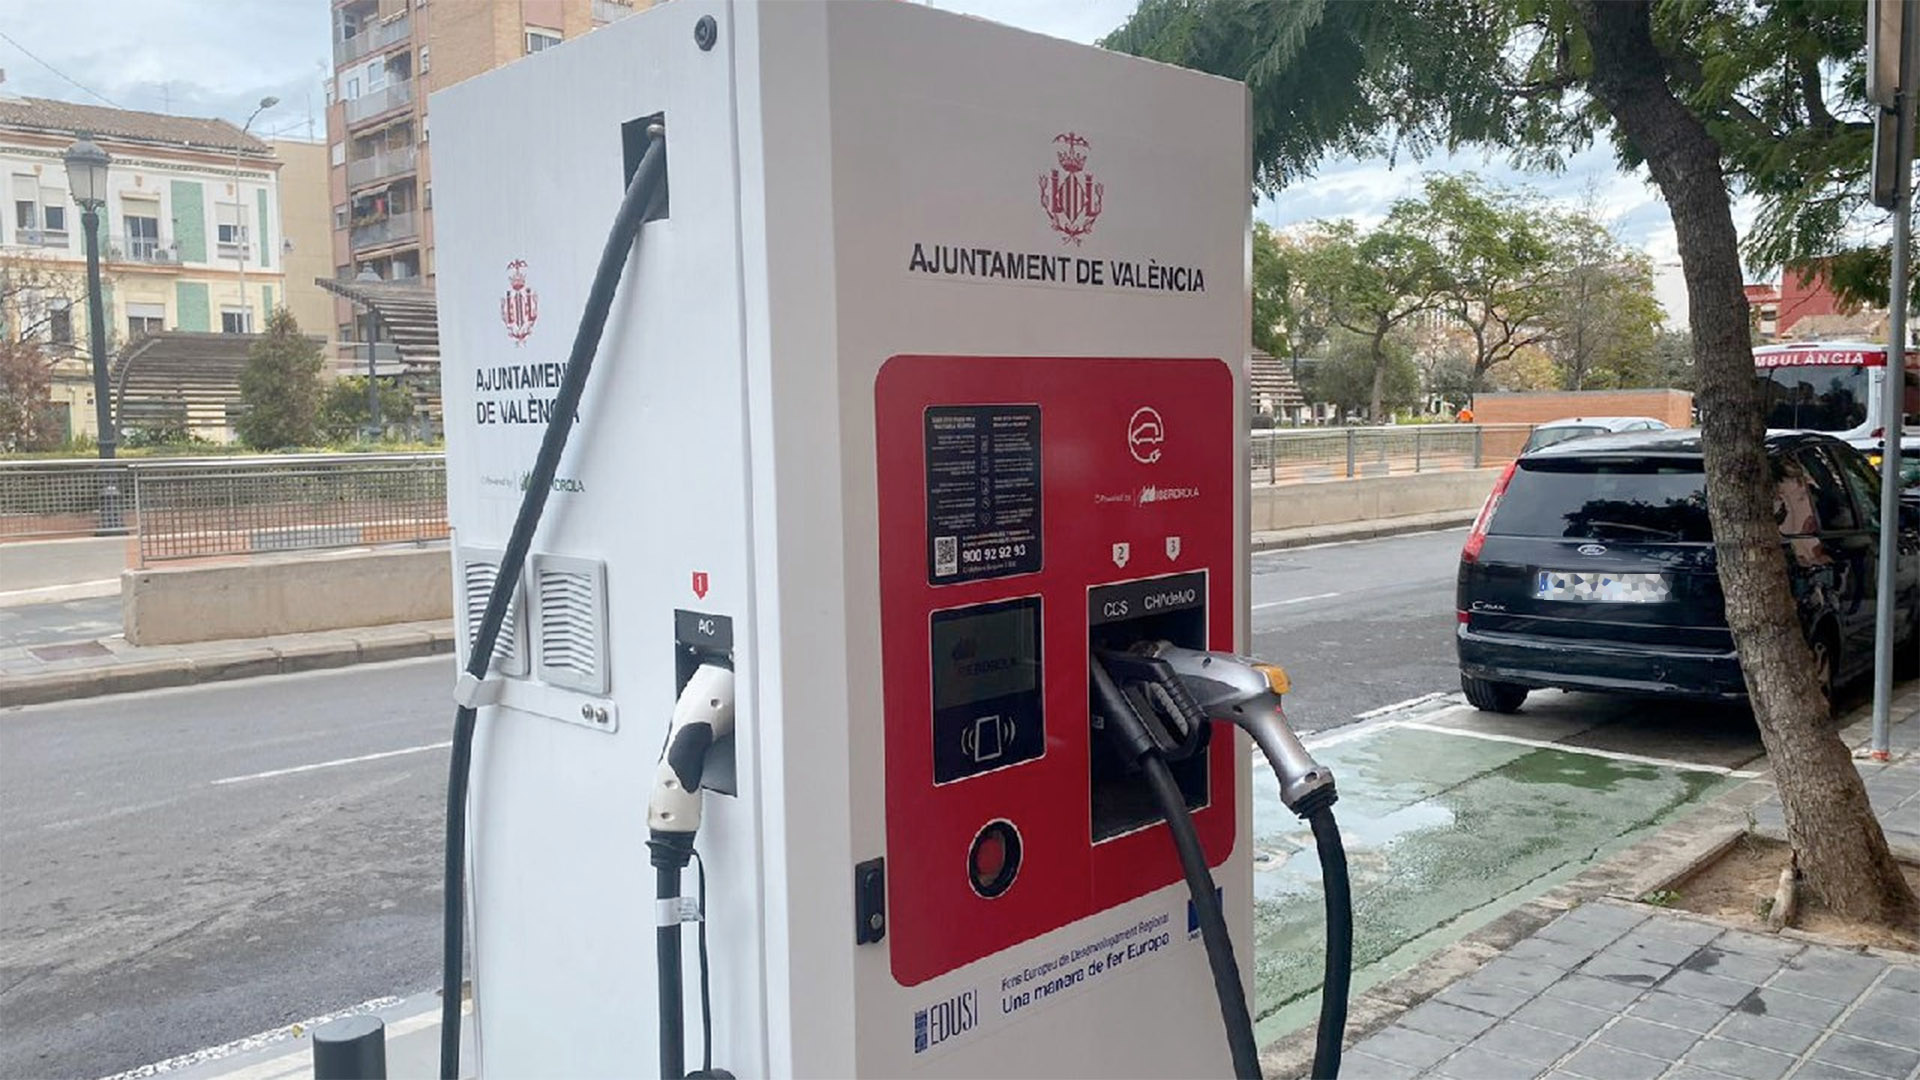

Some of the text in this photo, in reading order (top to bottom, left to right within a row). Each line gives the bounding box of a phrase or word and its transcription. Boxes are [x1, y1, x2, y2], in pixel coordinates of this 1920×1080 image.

[909, 243, 1206, 292] AJUNTAMENT DE VALÈNCIA
[476, 362, 568, 392] AJUNTAMEN
[477, 401, 496, 425] DE
[962, 543, 1027, 563] 900 92 92 93
[1103, 588, 1196, 617] CCS CHAdeMO
[698, 618, 715, 636] AC
[1001, 974, 1023, 991] Fons
[1024, 959, 1058, 983] Europeu
[1059, 954, 1071, 967] de
[1139, 911, 1169, 936] Regional
[1002, 990, 1030, 1014] Una
[1034, 968, 1084, 1000] manera
[1088, 958, 1104, 977] de
[1106, 950, 1124, 970] fer
[1127, 931, 1170, 960] Europa
[930, 988, 978, 1046] EDUSI
